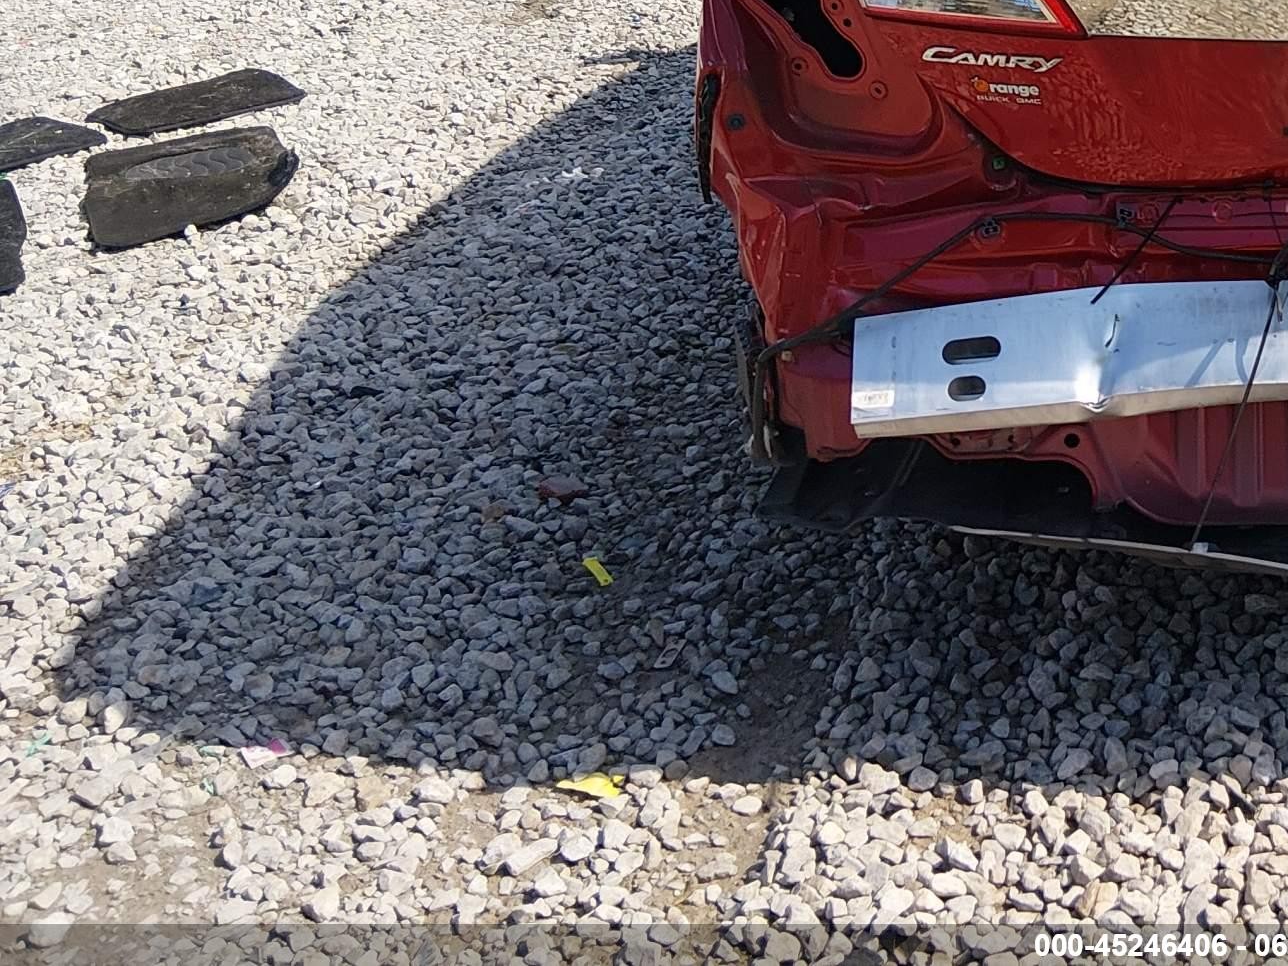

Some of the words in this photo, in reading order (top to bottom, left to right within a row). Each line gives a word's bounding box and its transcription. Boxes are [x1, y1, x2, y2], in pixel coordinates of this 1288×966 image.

[922, 46, 1063, 72] CAMRY
[976, 94, 1010, 103] BUICK
[1015, 96, 1042, 104] GMC
